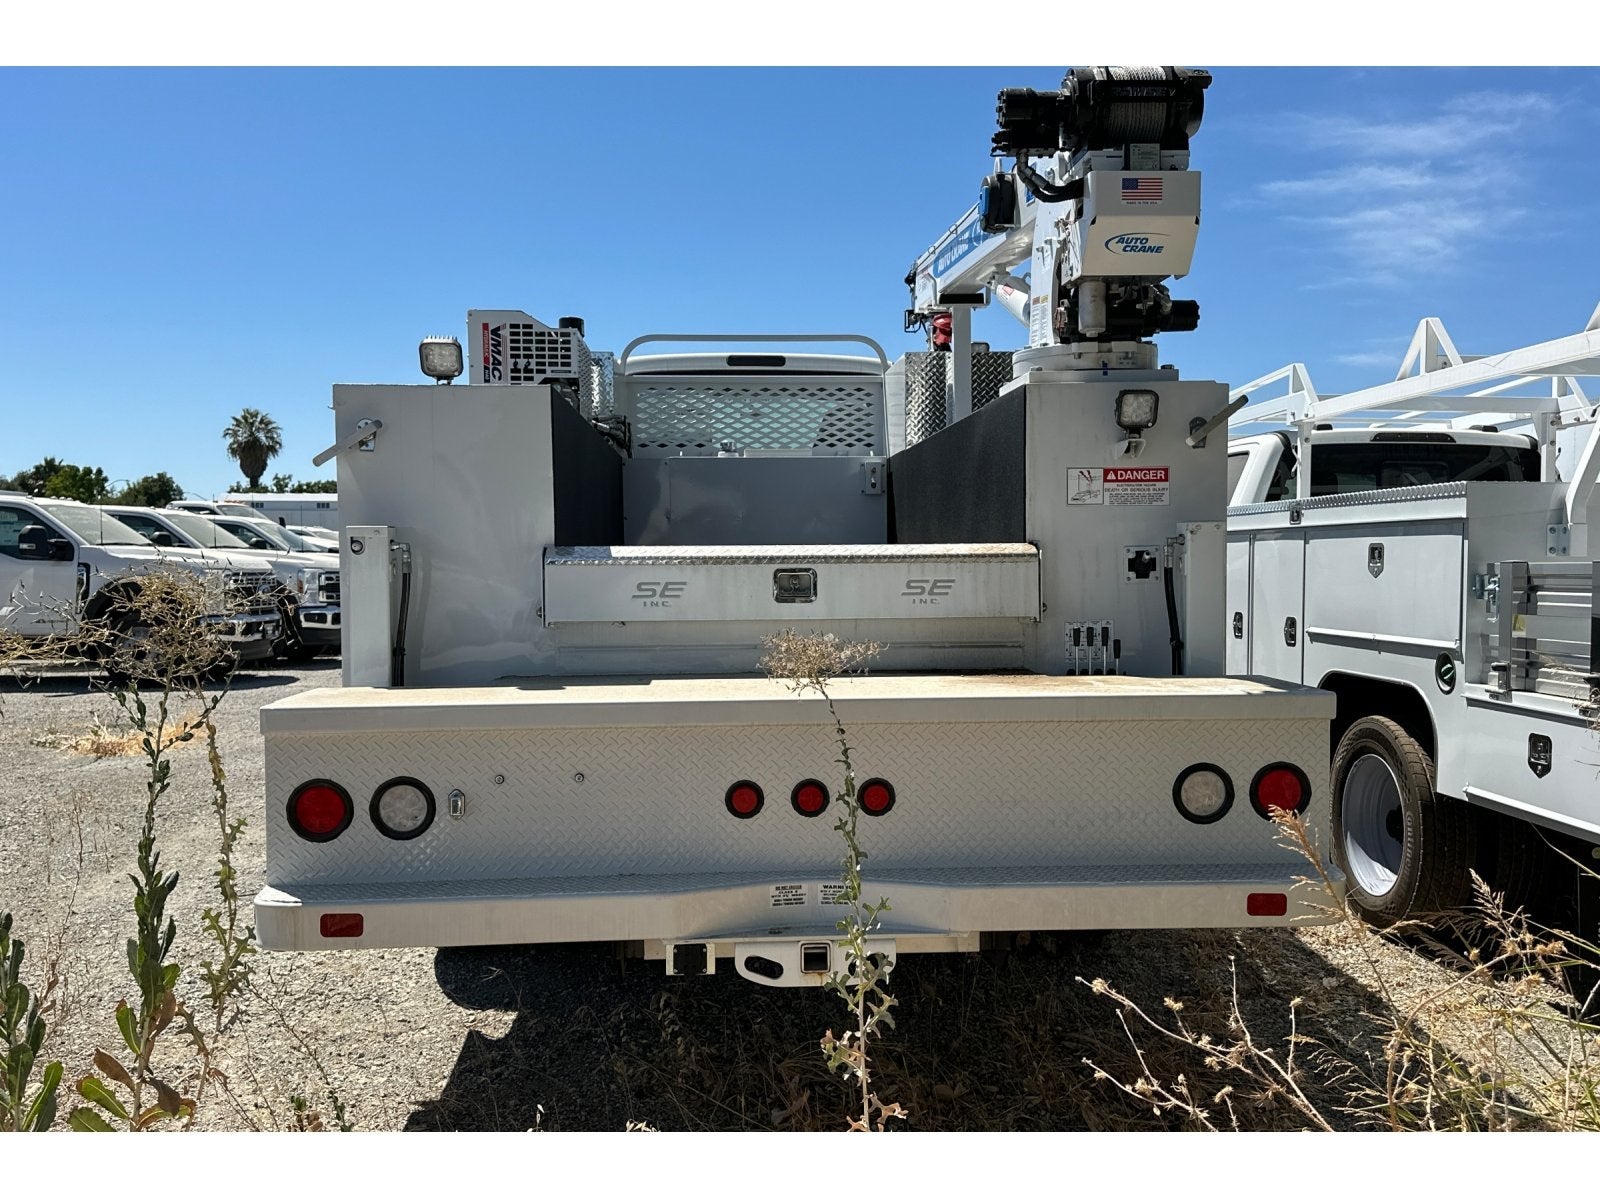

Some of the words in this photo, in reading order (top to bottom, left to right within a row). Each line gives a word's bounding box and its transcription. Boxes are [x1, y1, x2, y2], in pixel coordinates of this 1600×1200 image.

[1116, 237, 1149, 245] AUTO
[1122, 245, 1164, 254] CRANE
[491, 323, 506, 381] VMAC
[1117, 470, 1165, 480] DANGER
[632, 581, 687, 599] SE
[901, 579, 956, 596] SE
